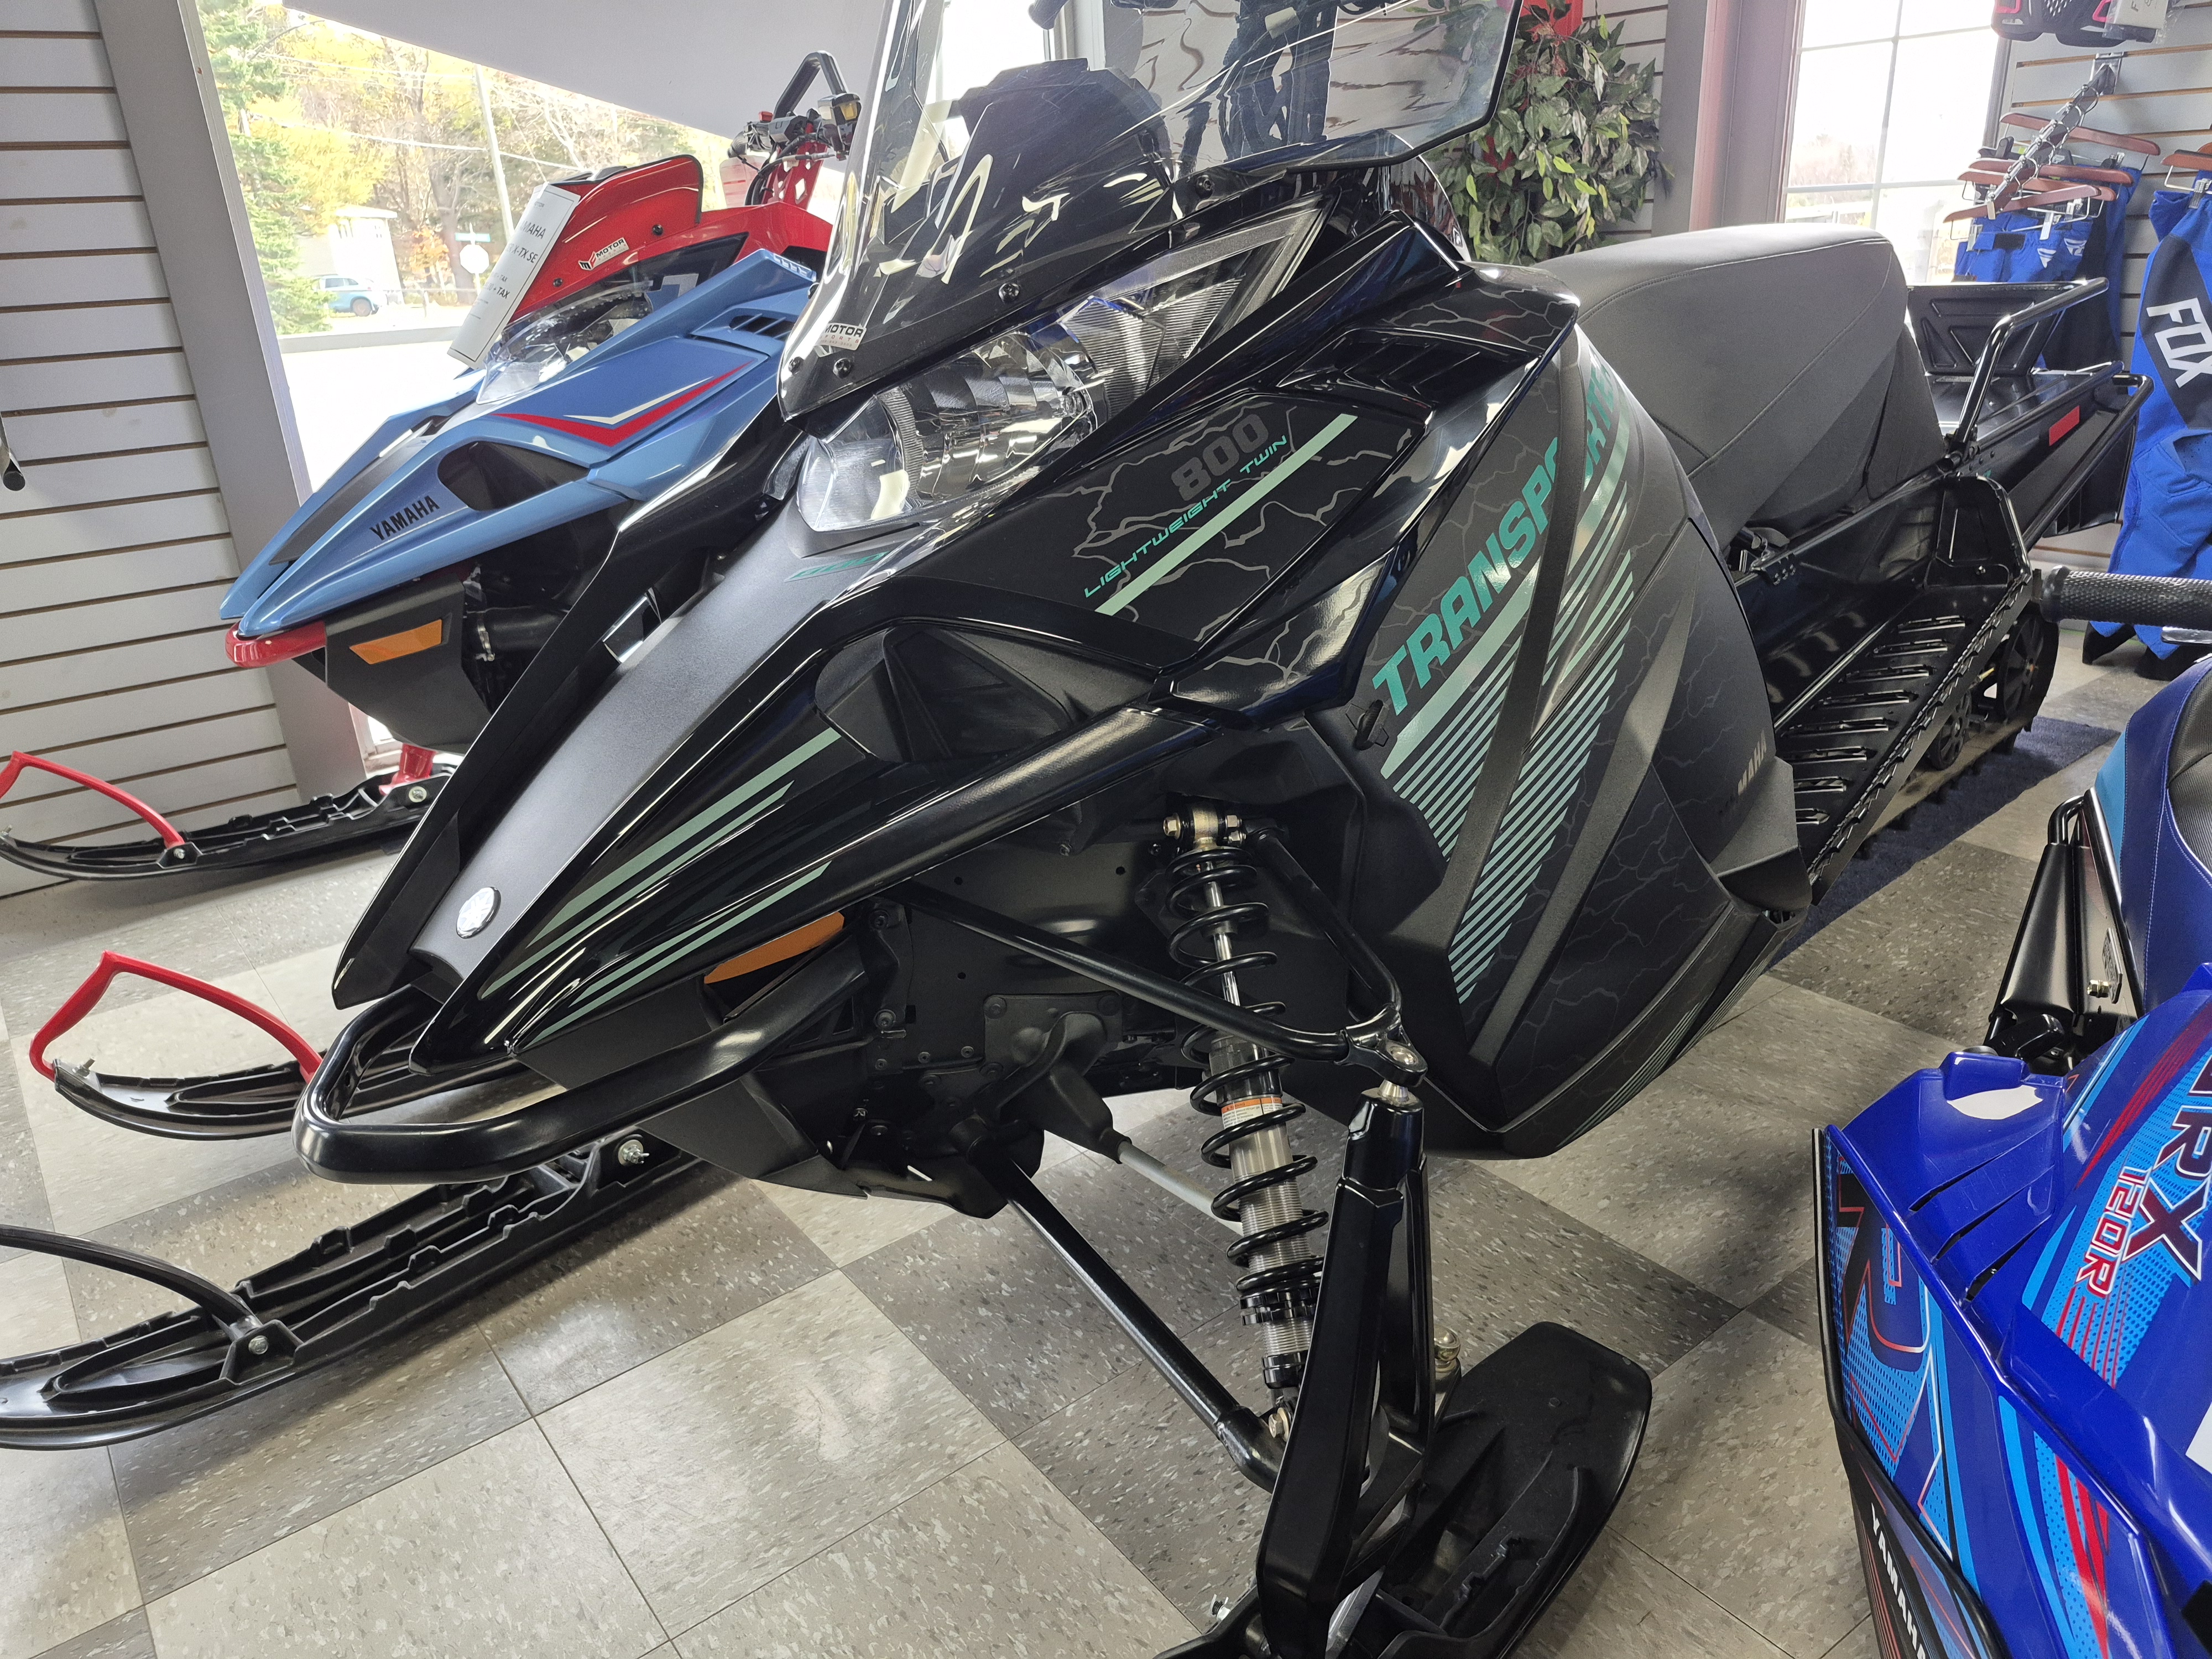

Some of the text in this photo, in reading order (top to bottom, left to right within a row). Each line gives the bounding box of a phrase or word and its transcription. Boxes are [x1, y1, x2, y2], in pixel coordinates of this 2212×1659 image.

[520, 221, 546, 239] MAHA
[526, 252, 538, 263] SE
[596, 238, 624, 258] MOTOR
[497, 286, 510, 299] TAX
[821, 335, 859, 343] PORTS
[824, 324, 864, 338] MOTOR
[1171, 414, 1269, 501] 800
[369, 495, 440, 541] YAMAHA
[1084, 435, 1287, 598] LIGHTWEIGHT TWIN
[2122, 1055, 2212, 1281] RX
[2076, 1166, 2152, 1295] 120R
